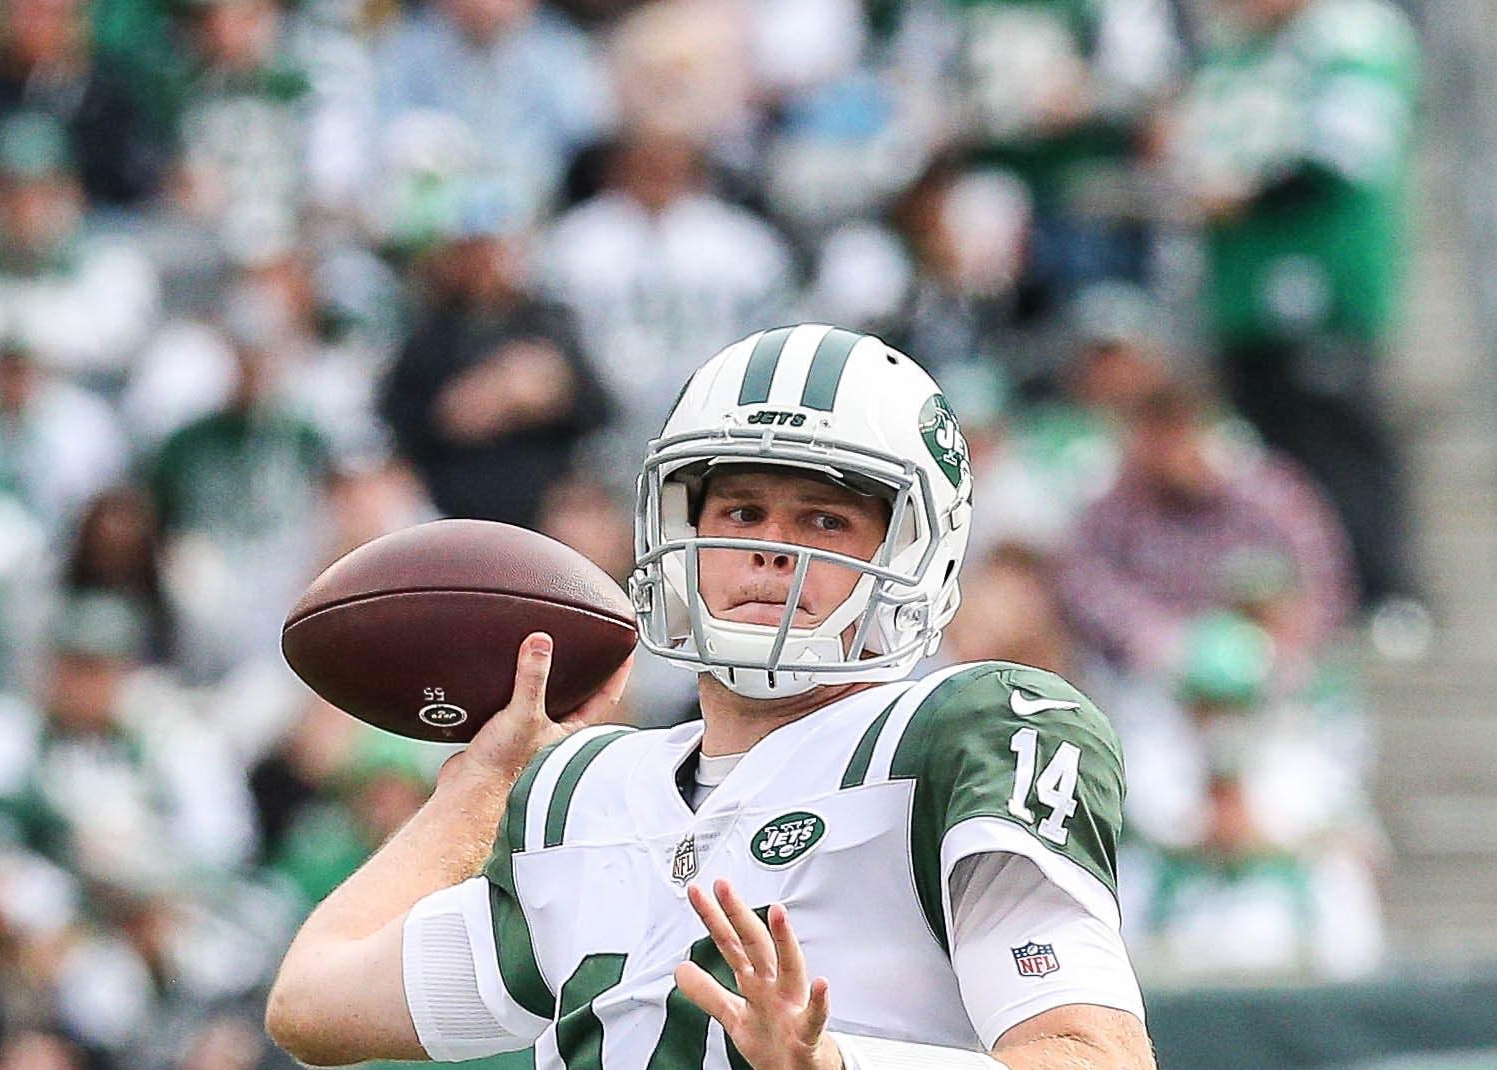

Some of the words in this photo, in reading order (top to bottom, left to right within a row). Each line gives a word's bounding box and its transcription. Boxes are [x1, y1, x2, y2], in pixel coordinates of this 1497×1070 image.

[748, 410, 807, 427] JETS
[1007, 726, 1082, 846] 14
[758, 825, 815, 852] JETS
[674, 851, 697, 877] NFL
[1019, 955, 1056, 974] NFL
